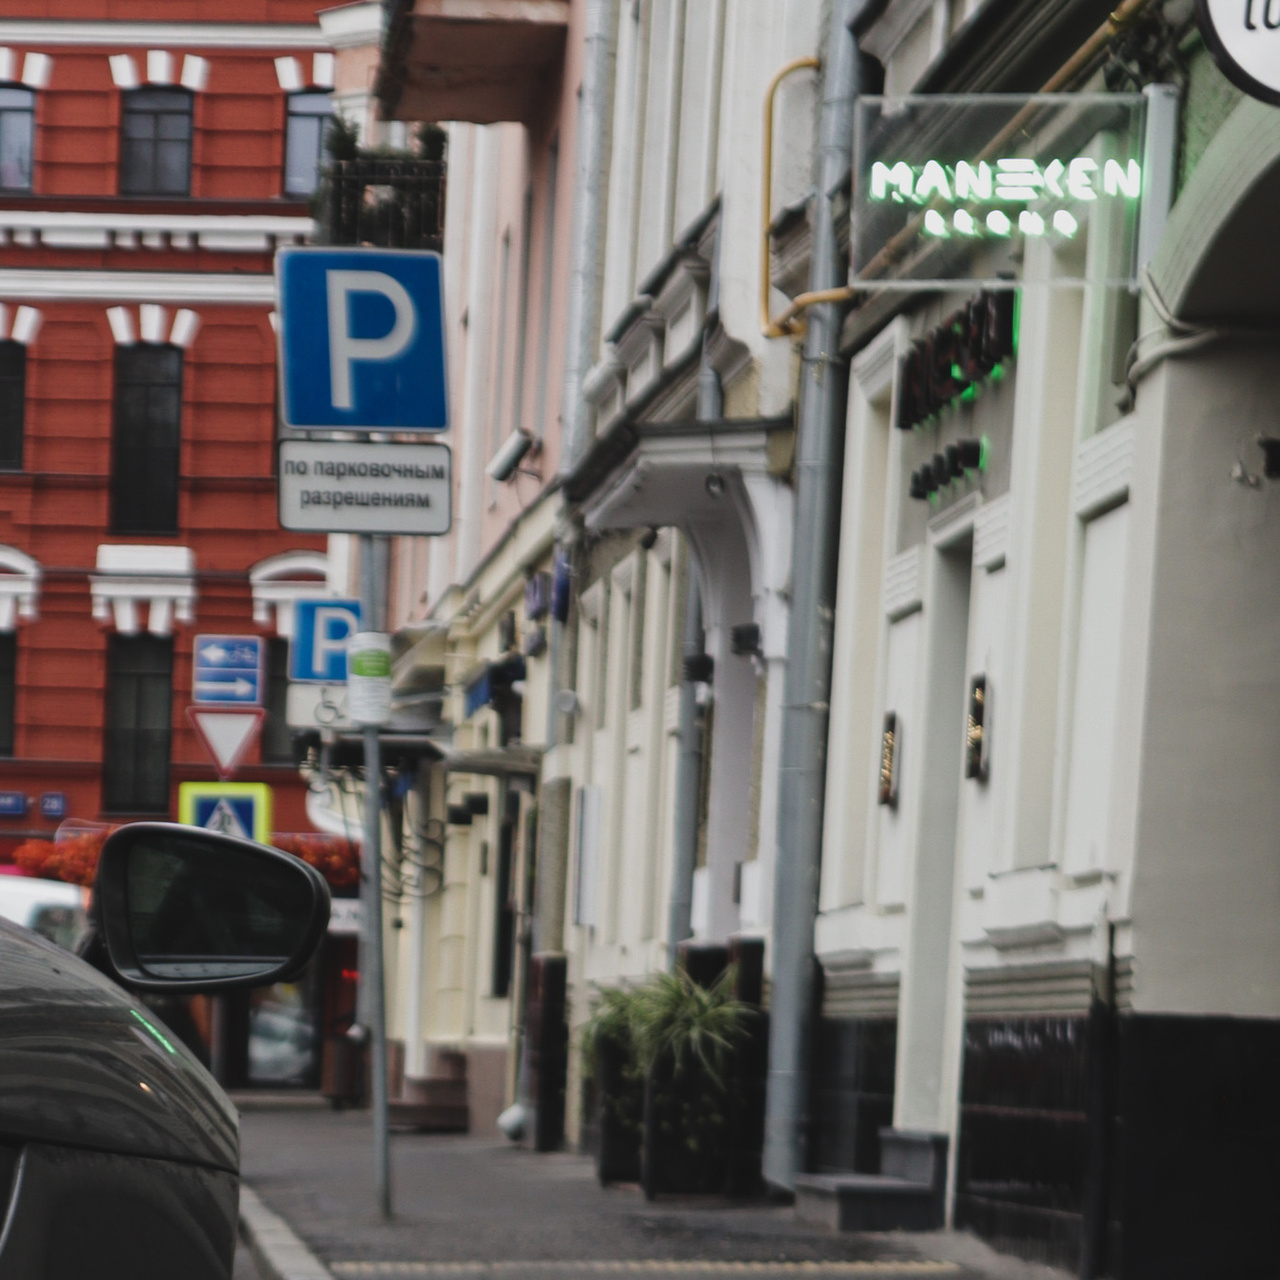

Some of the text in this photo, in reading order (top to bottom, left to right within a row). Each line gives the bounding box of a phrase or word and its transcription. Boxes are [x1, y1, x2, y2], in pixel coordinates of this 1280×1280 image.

[869, 157, 1141, 200] MANEKEN
[325, 269, 416, 408] P
[284, 459, 446, 480] по парковочным
[300, 488, 431, 509] разрешениям
[311, 605, 359, 673] P
